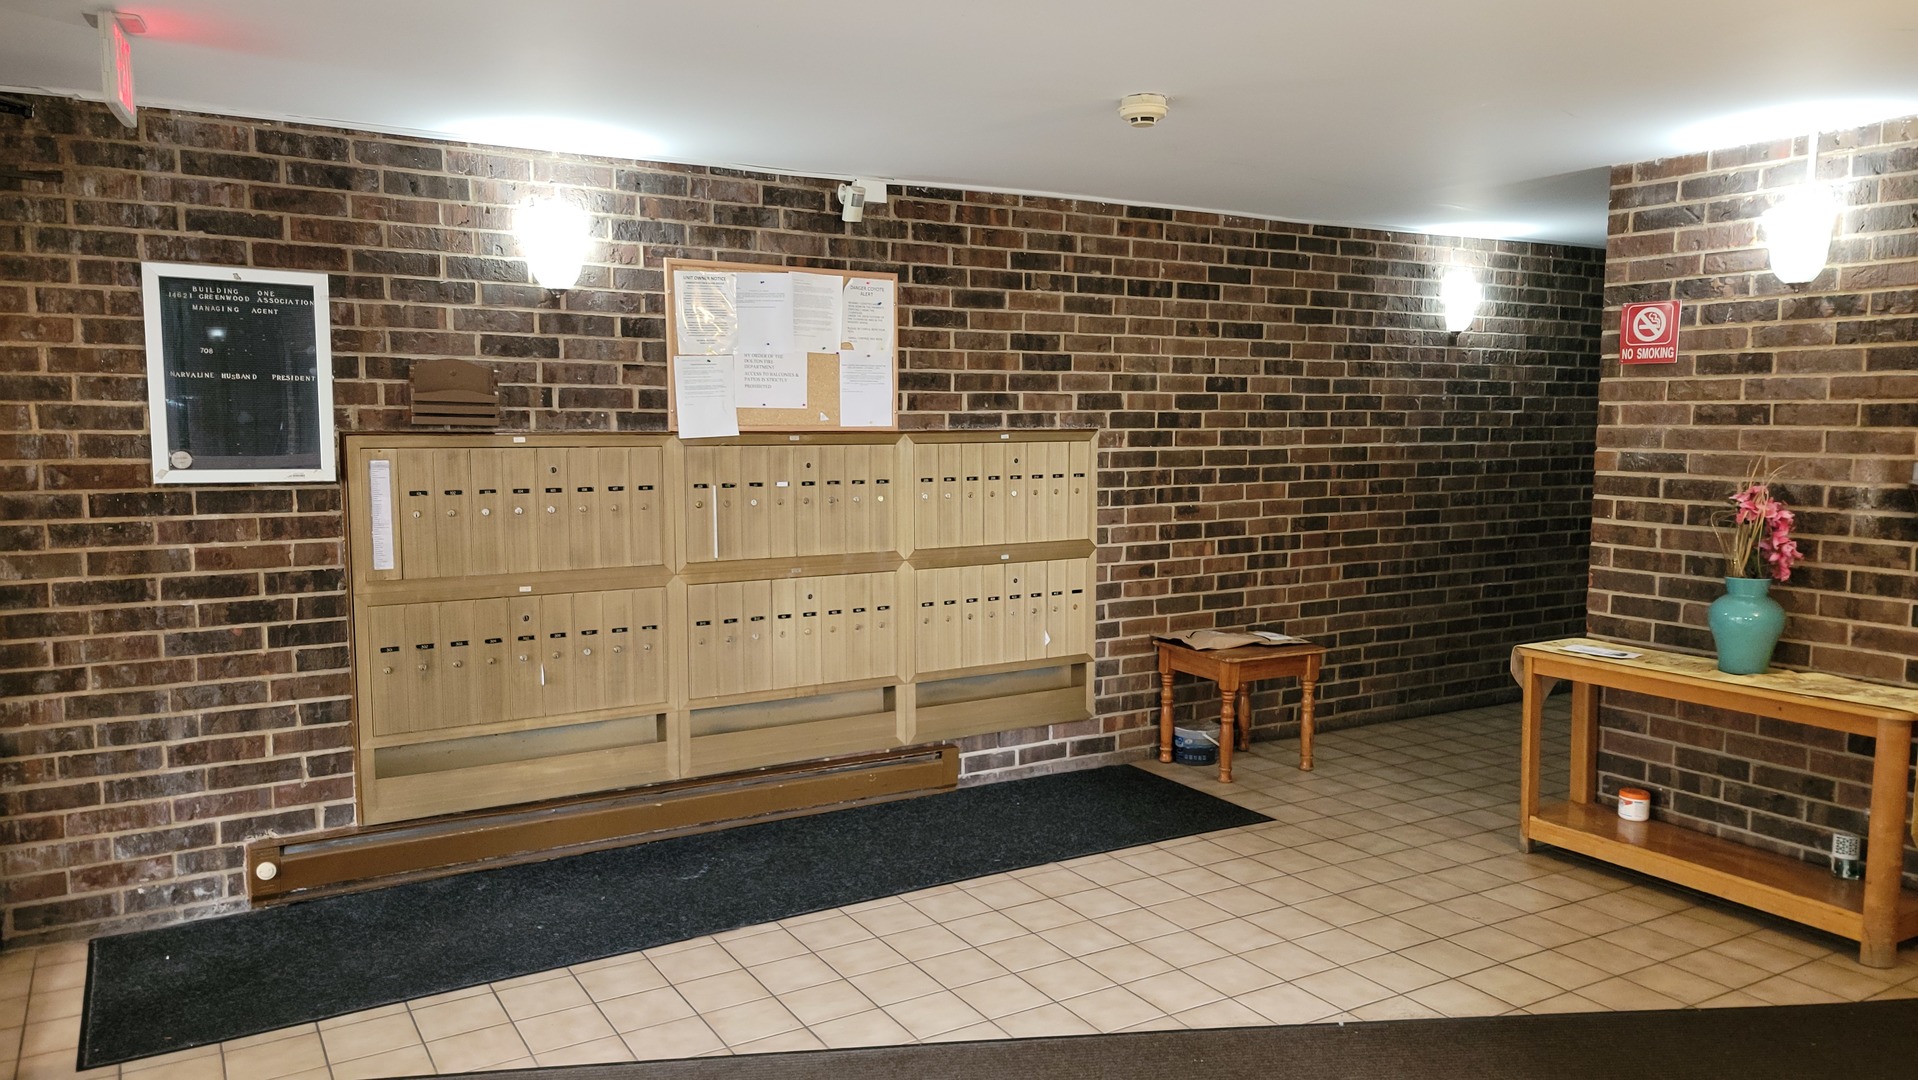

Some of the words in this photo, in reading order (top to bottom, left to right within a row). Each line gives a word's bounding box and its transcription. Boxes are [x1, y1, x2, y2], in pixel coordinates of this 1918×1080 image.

[192, 286, 239, 295] BUILDING
[198, 294, 250, 302] GREENWOOD
[257, 297, 314, 306] ASSOCIATION
[192, 304, 240, 313] MANAGING
[1622, 348, 1634, 360] NO
[1636, 346, 1675, 360] SMOKING
[272, 374, 316, 382] PRESIDENT
